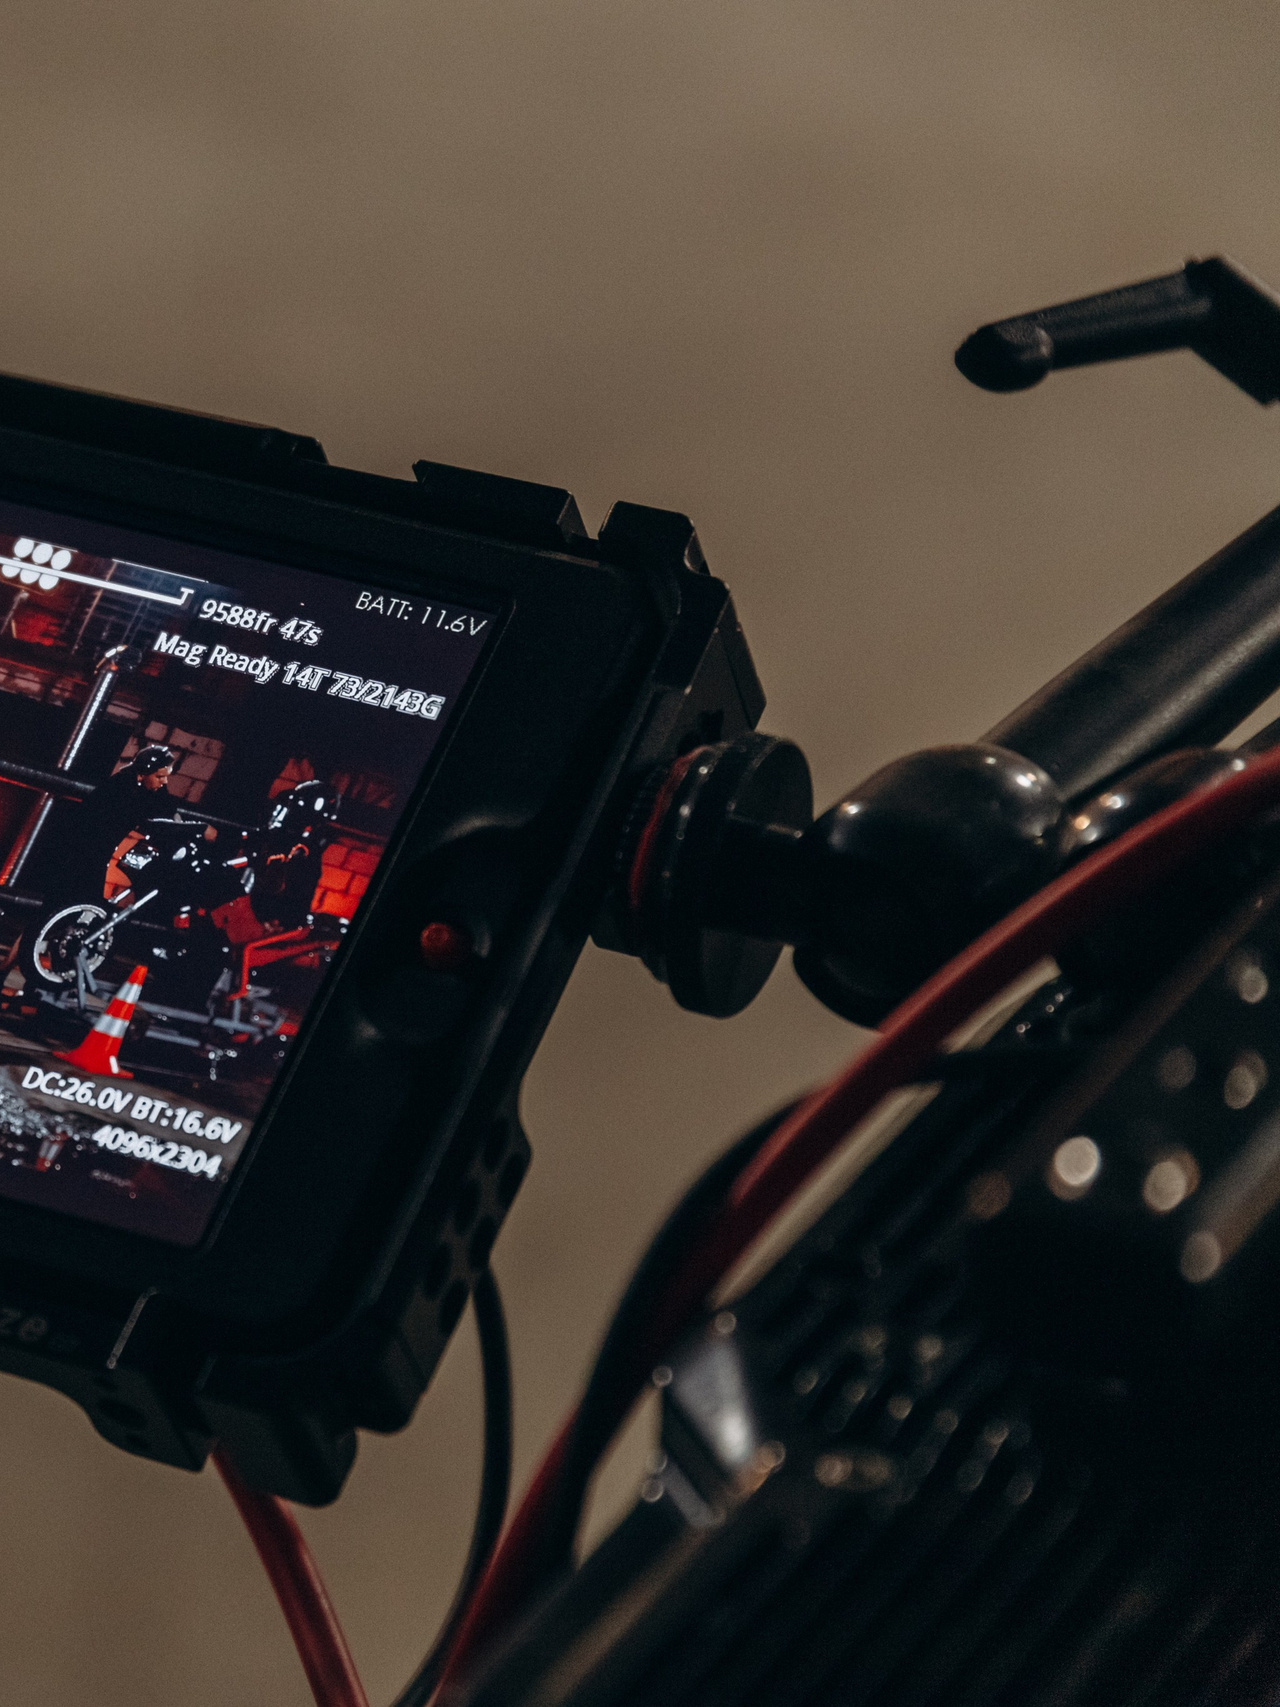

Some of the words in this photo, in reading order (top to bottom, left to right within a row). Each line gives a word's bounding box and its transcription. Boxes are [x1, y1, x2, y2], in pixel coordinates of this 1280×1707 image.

[198, 598, 278, 636] 9588fr
[279, 616, 325, 647] 47s
[355, 590, 414, 621] BATT:
[420, 605, 489, 637] 11.6V
[152, 631, 209, 668] Mag
[208, 644, 281, 685] Ready
[282, 661, 331, 692] 14T
[21, 1065, 134, 1114] DC:26.0V
